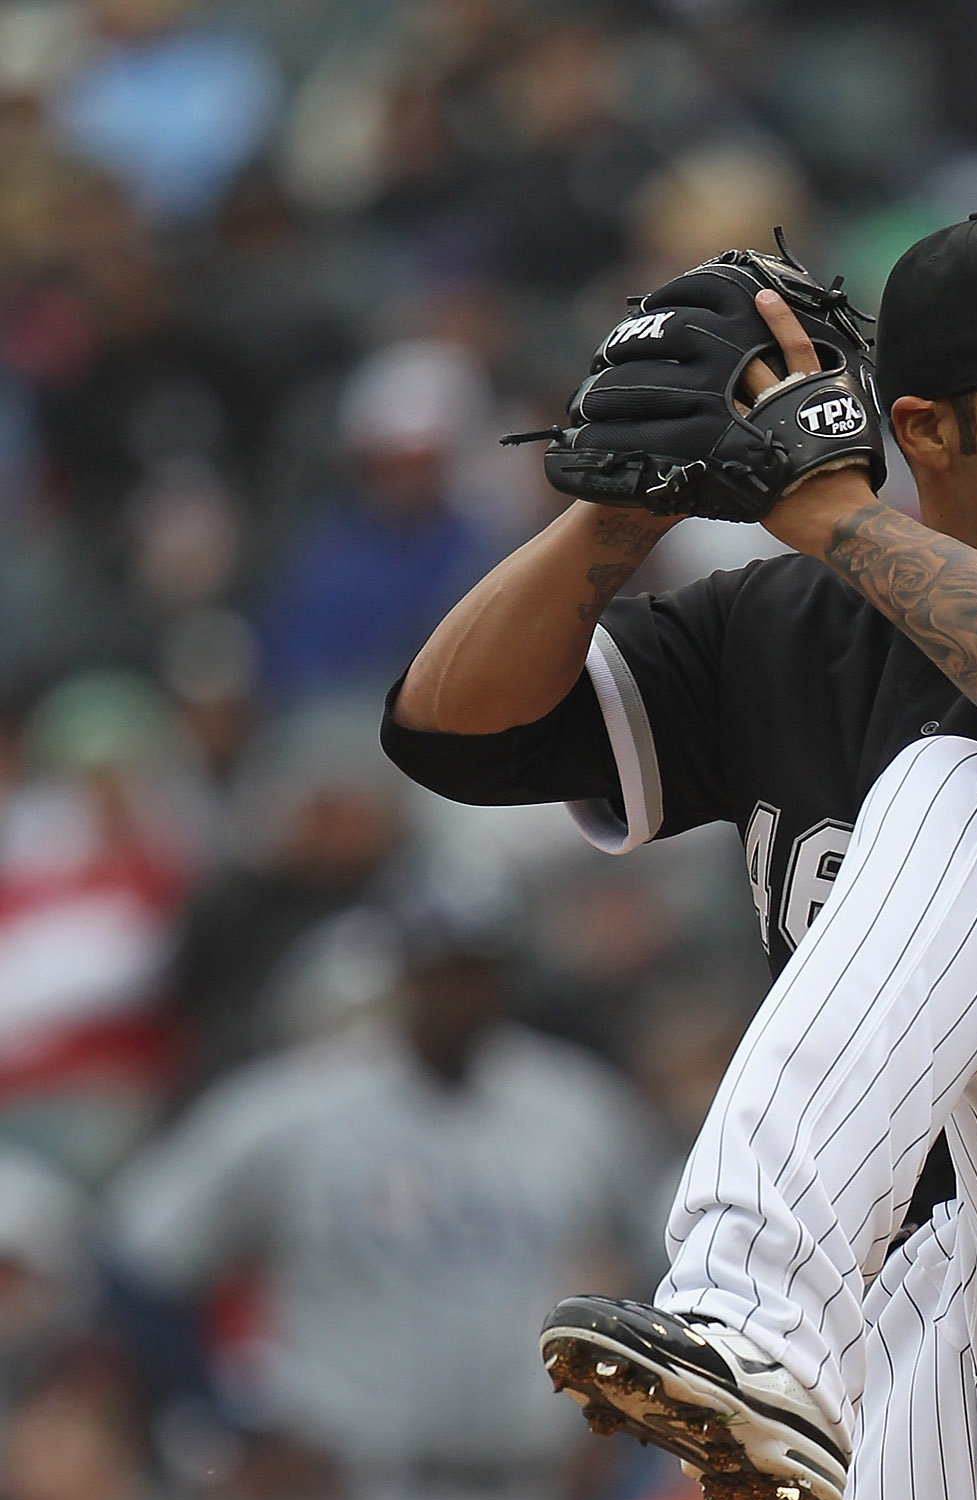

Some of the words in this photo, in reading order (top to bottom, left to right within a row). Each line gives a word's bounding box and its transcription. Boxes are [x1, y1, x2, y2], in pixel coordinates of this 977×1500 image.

[608, 311, 676, 348] TPX
[800, 397, 862, 432] TPX
[832, 420, 855, 434] PRO
